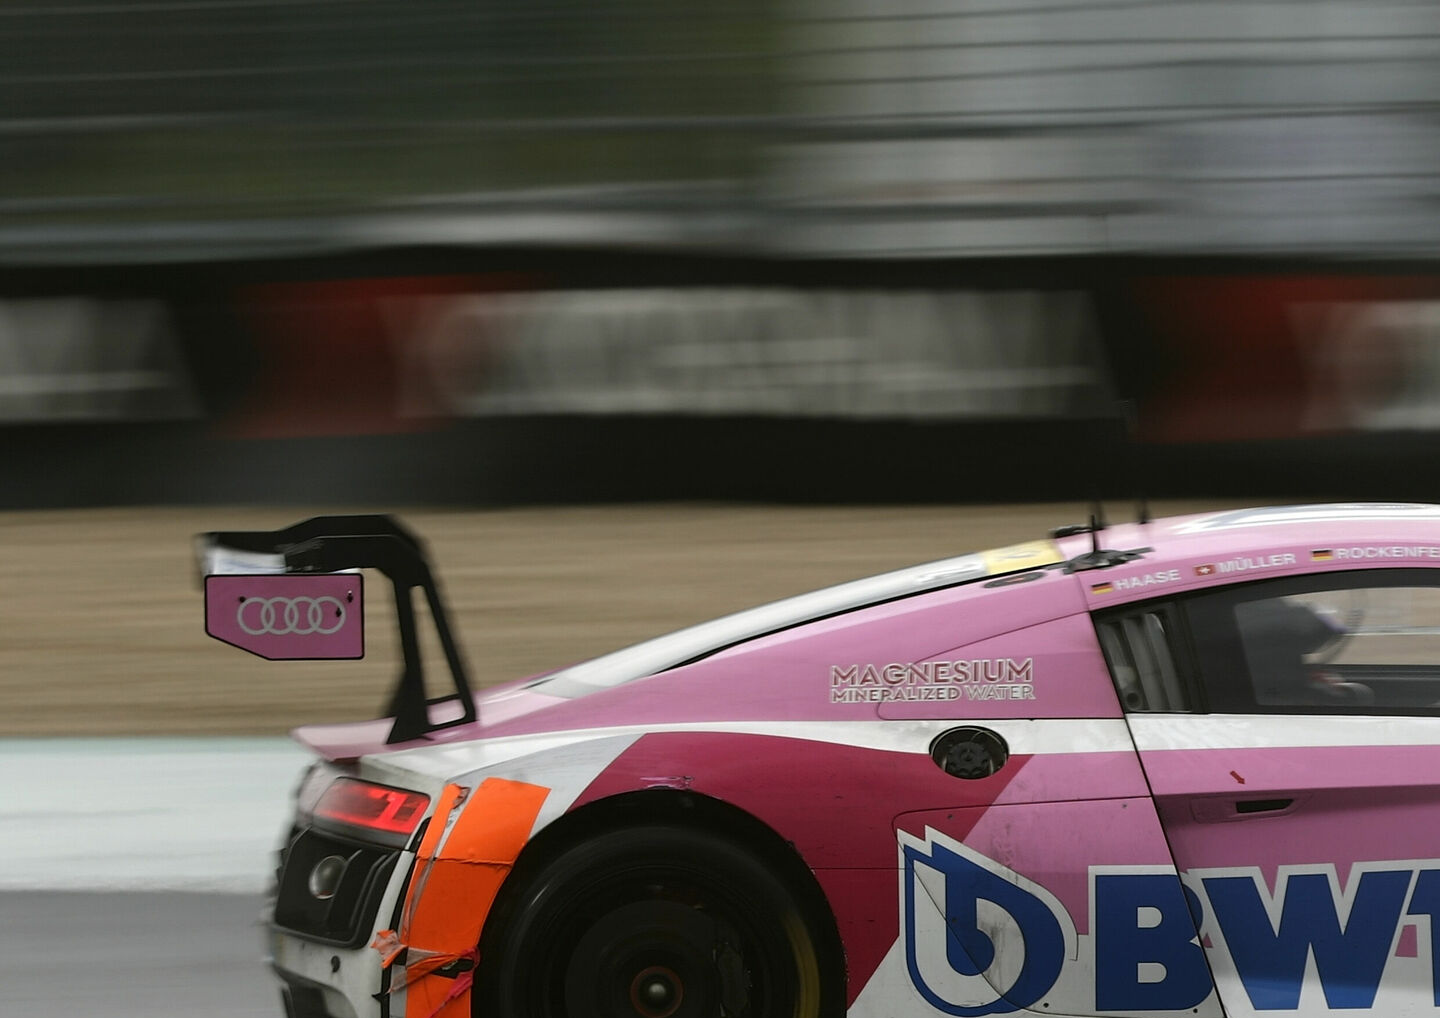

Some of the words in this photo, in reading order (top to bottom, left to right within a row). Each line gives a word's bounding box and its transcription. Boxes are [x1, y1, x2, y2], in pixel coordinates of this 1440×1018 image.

[1217, 553, 1296, 573] MÜLLER
[1114, 569, 1181, 590] HAASE
[831, 657, 1034, 688] MAGNESIUM
[830, 685, 961, 704] MINERALIZED
[967, 683, 1036, 701] WATER
